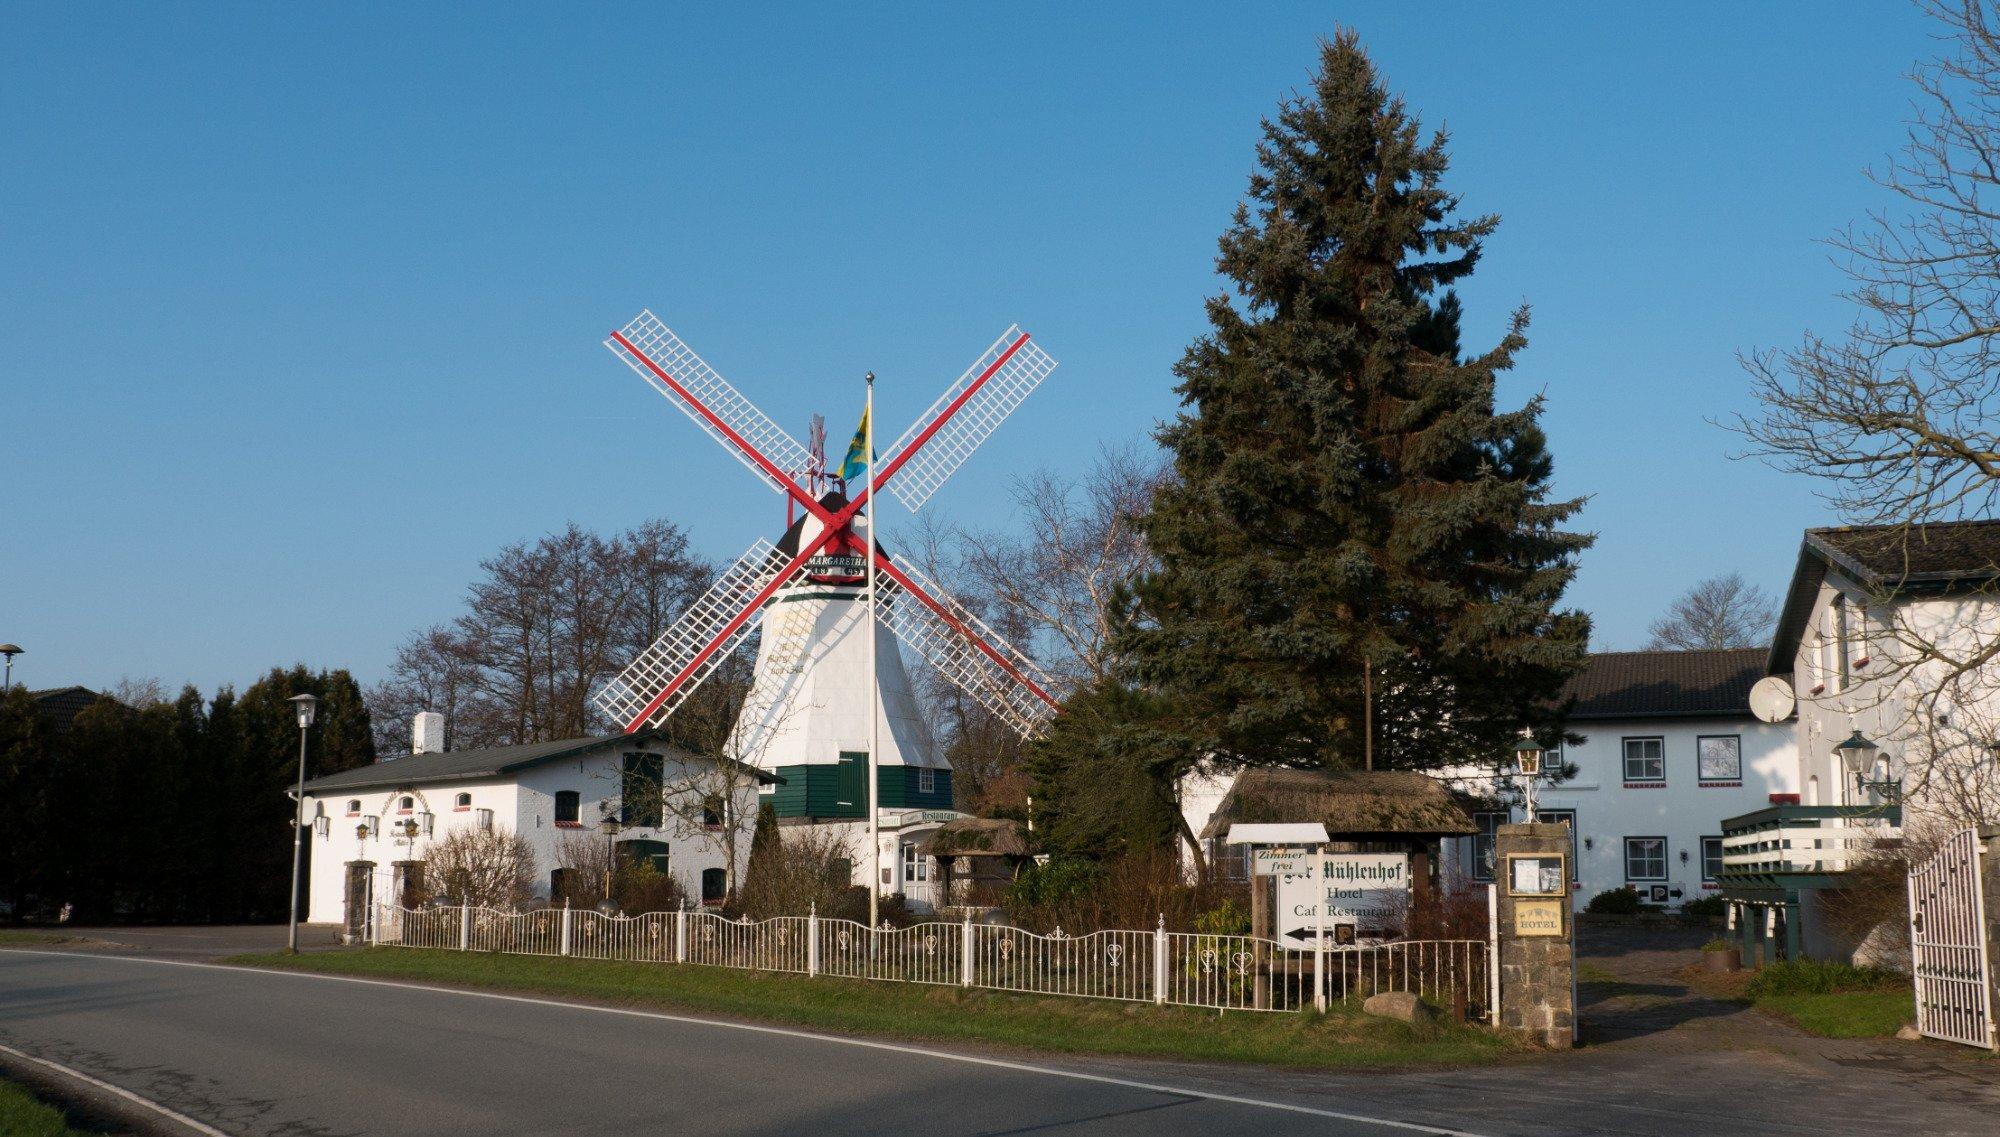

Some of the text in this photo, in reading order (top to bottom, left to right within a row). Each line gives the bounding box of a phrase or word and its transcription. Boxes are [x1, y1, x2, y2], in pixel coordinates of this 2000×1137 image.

[808, 556, 867, 566] MARGARETHA
[1271, 861, 1293, 872] frei
[1327, 887, 1363, 899] Hotel
[1294, 904, 1318, 917] Caf
[1520, 920, 1558, 929] HOTEL
